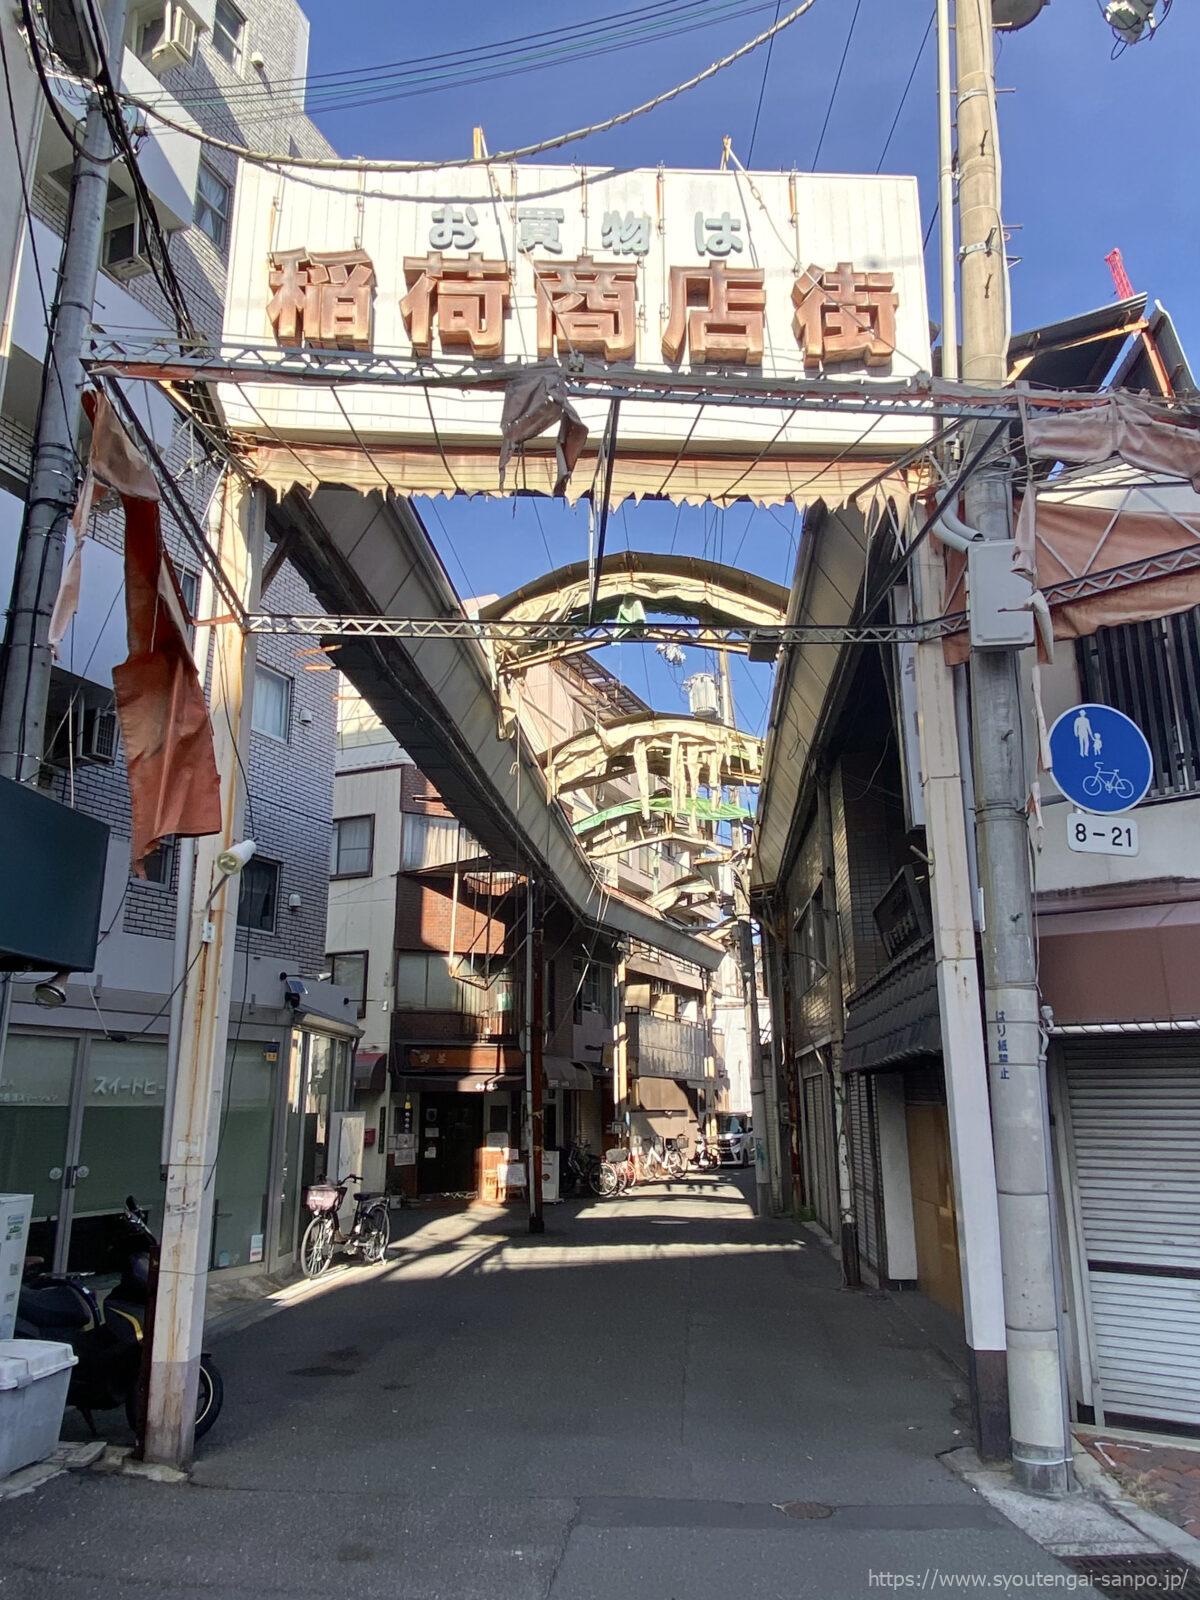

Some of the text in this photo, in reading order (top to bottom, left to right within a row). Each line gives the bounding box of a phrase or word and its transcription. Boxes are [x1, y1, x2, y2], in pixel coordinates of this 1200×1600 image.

[429, 205, 743, 255] お買物は
[265, 247, 899, 366] 稲荷商店街
[1075, 822, 1132, 848] 8-21
